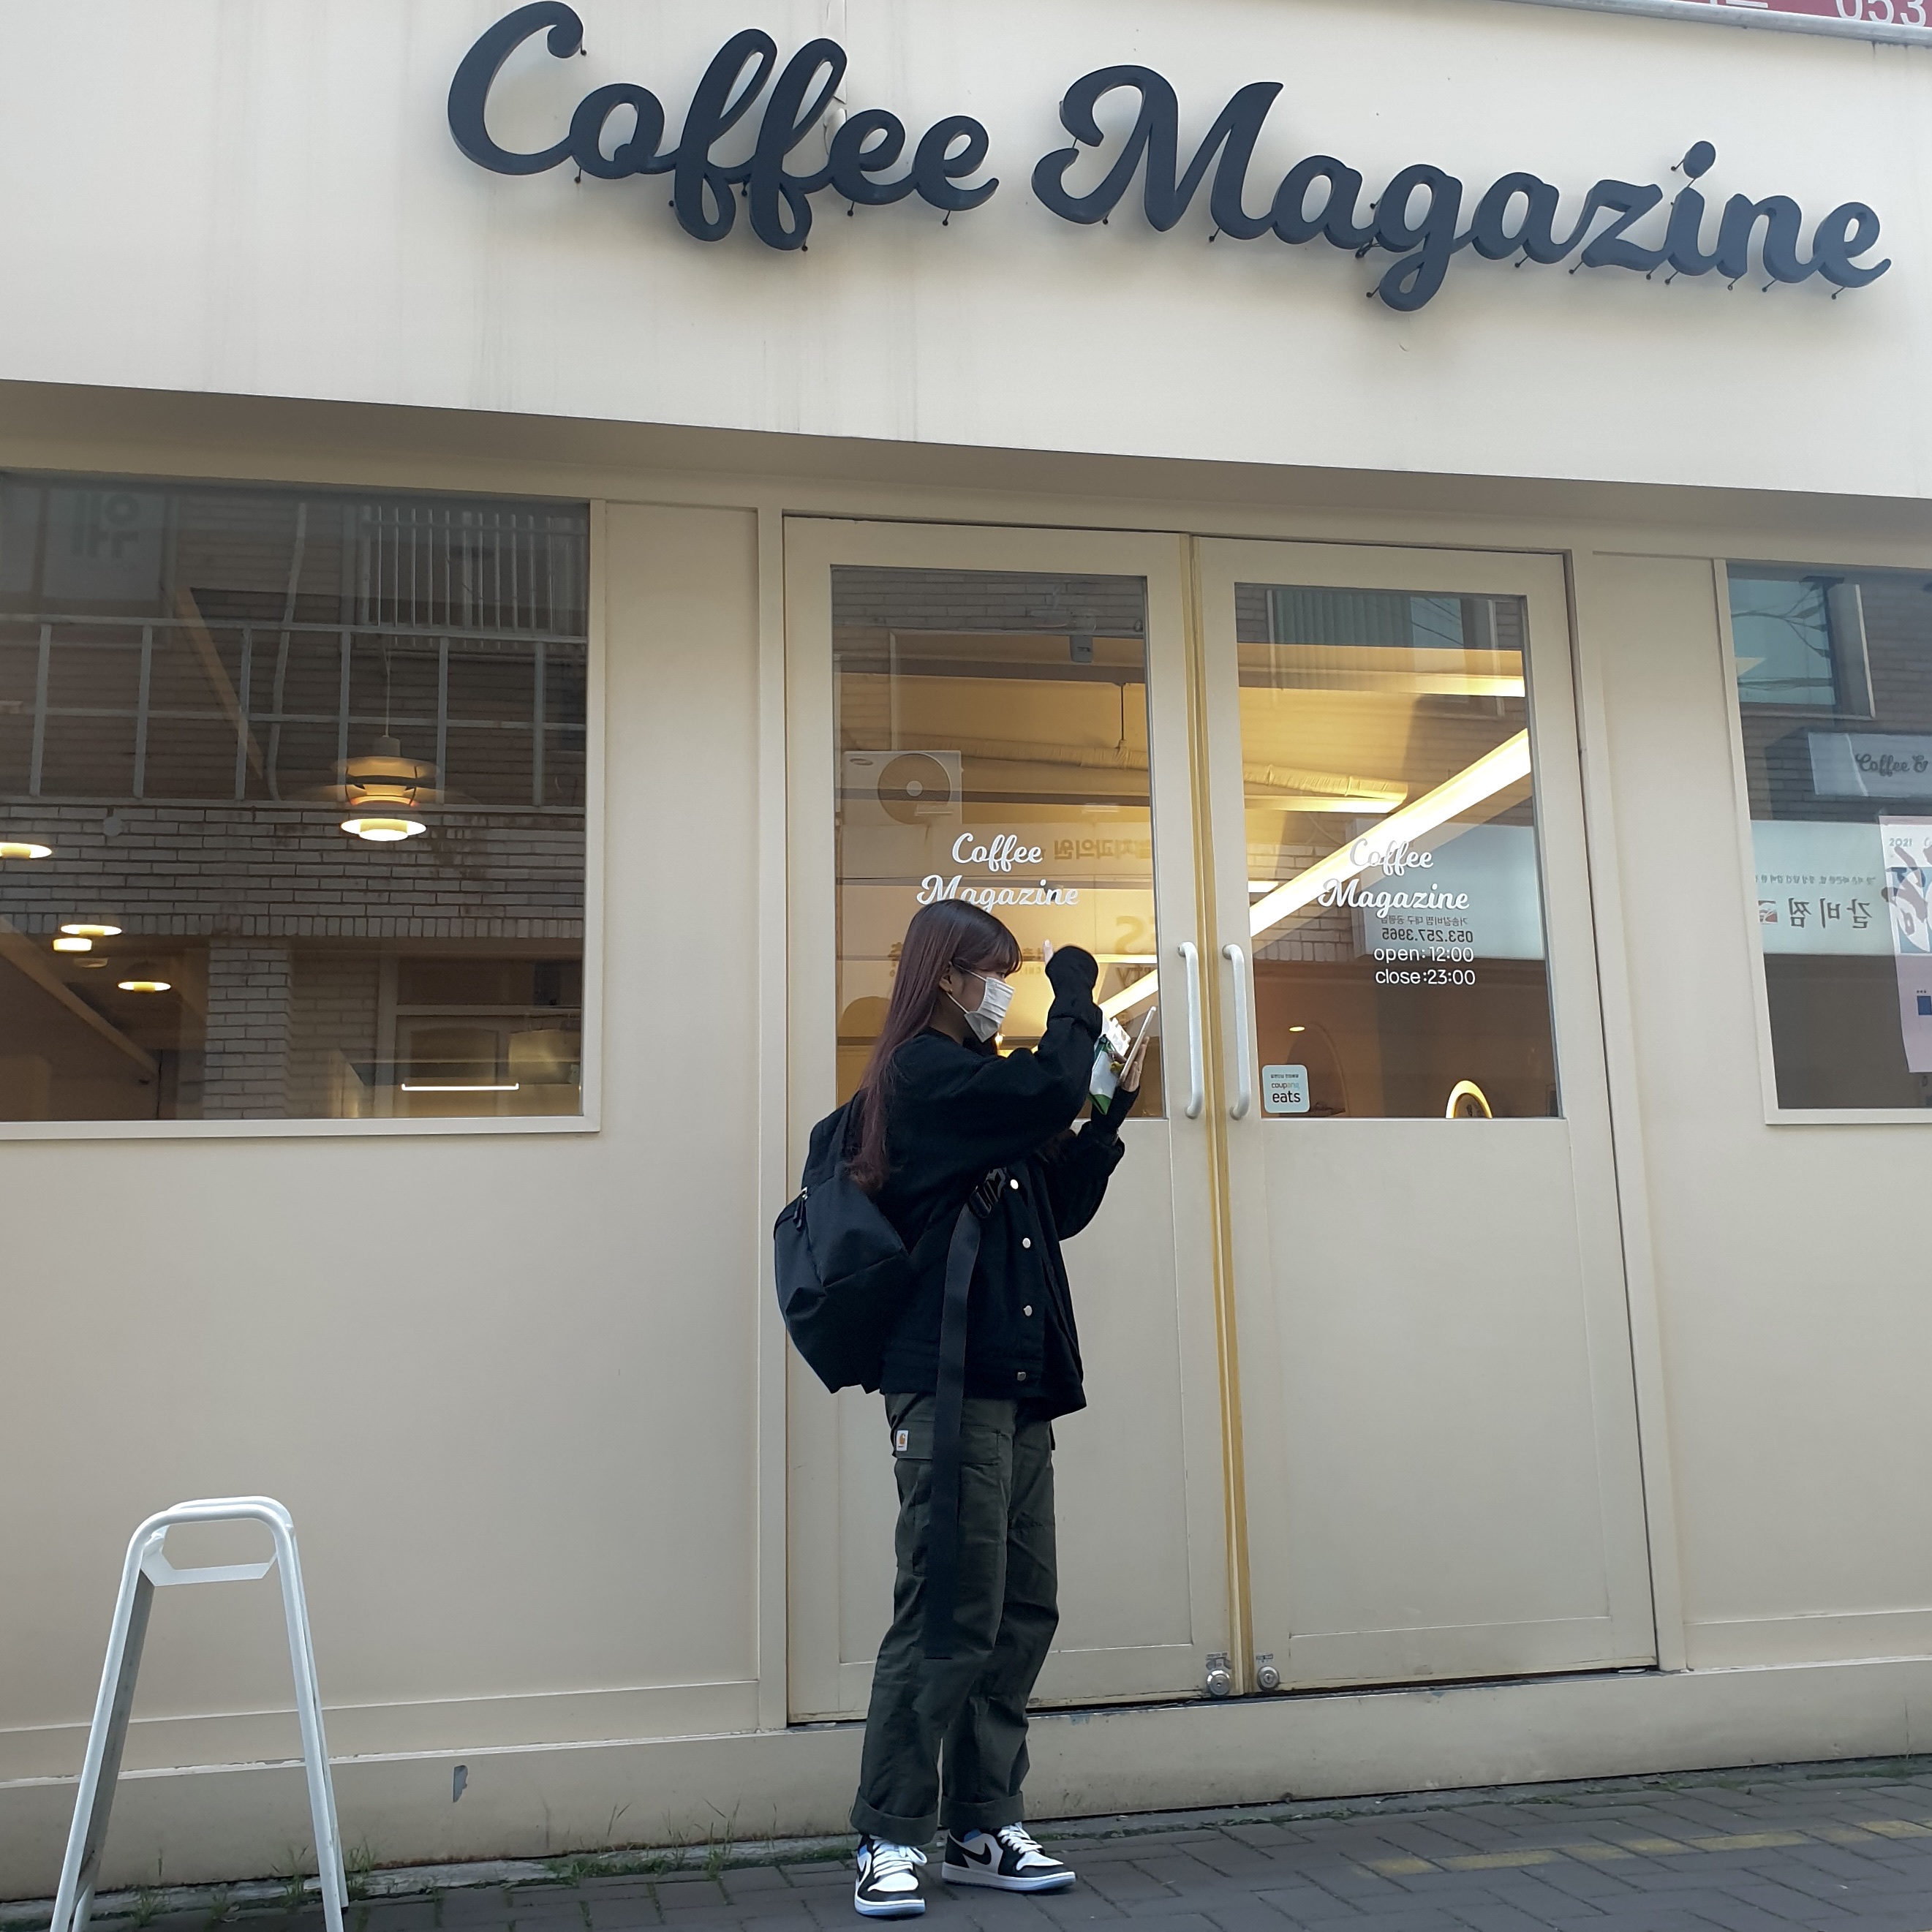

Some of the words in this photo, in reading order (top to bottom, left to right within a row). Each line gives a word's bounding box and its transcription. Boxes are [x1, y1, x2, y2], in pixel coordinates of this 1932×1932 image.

[448, 1, 1000, 252] Coffee
[1032, 64, 1892, 312] Magazine
[1855, 753, 1909, 777] Coffee
[952, 833, 1043, 872] Coffee
[1350, 838, 1433, 876] Coffee
[1889, 837, 1912, 847] 2021
[916, 875, 1080, 913] Magazine
[1318, 879, 1469, 918] Magazine
[1272, 1090, 1301, 1103] eats
